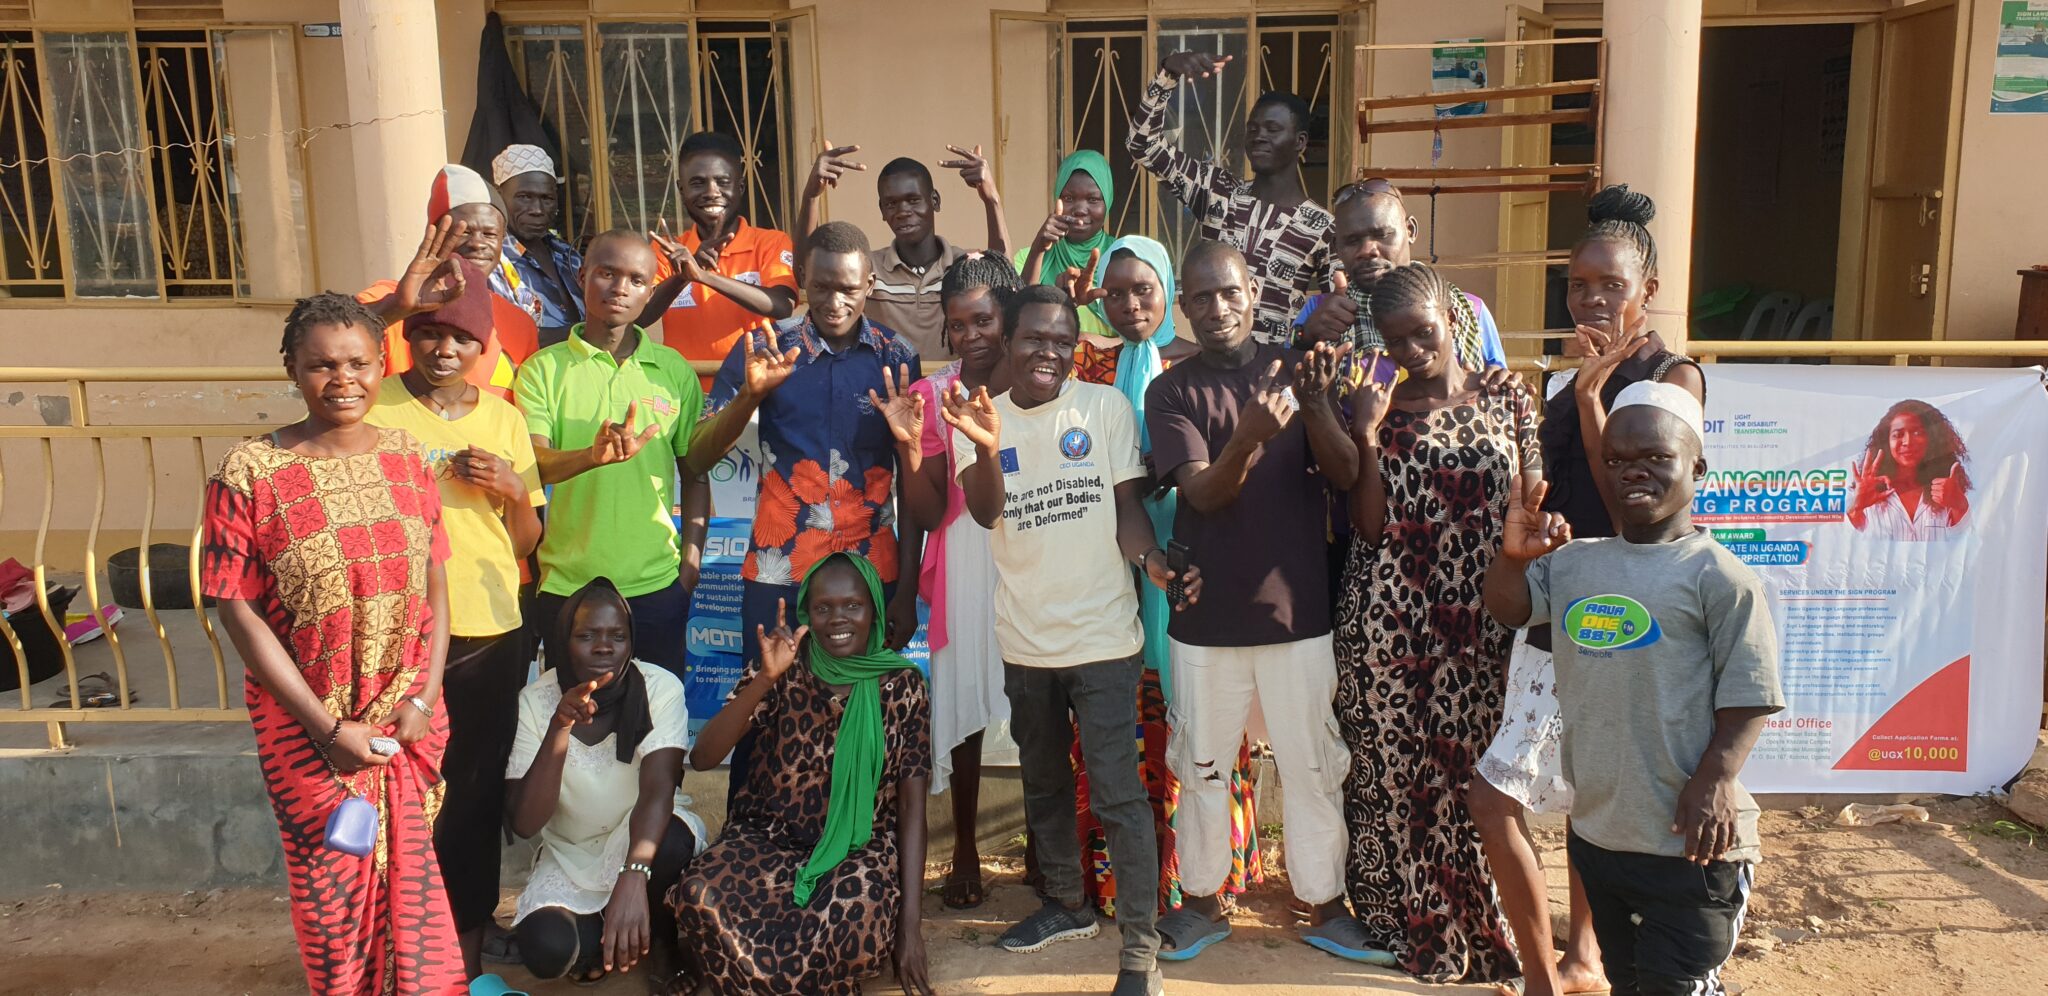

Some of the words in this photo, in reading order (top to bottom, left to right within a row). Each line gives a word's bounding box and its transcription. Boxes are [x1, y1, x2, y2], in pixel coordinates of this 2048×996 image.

[1703, 420, 1725, 433] DIT
[1020, 490, 1034, 501] are
[1036, 482, 1054, 497] not
[1056, 475, 1104, 491] Disabled,
[1002, 506, 1022, 520] only
[1024, 499, 1045, 514] that
[1047, 496, 1063, 509] our
[1066, 490, 1102, 505] Bodies
[1729, 498, 1842, 512] PROGRAM
[1017, 520, 1032, 531] are
[1749, 543, 1760, 552] IN
[1761, 543, 1800, 552] UGANDA
[721, 573, 744, 582] peop
[693, 590, 705, 599] for
[1623, 624, 1634, 632] FM
[695, 664, 729, 675] Bringing
[1796, 717, 1832, 728] Office
